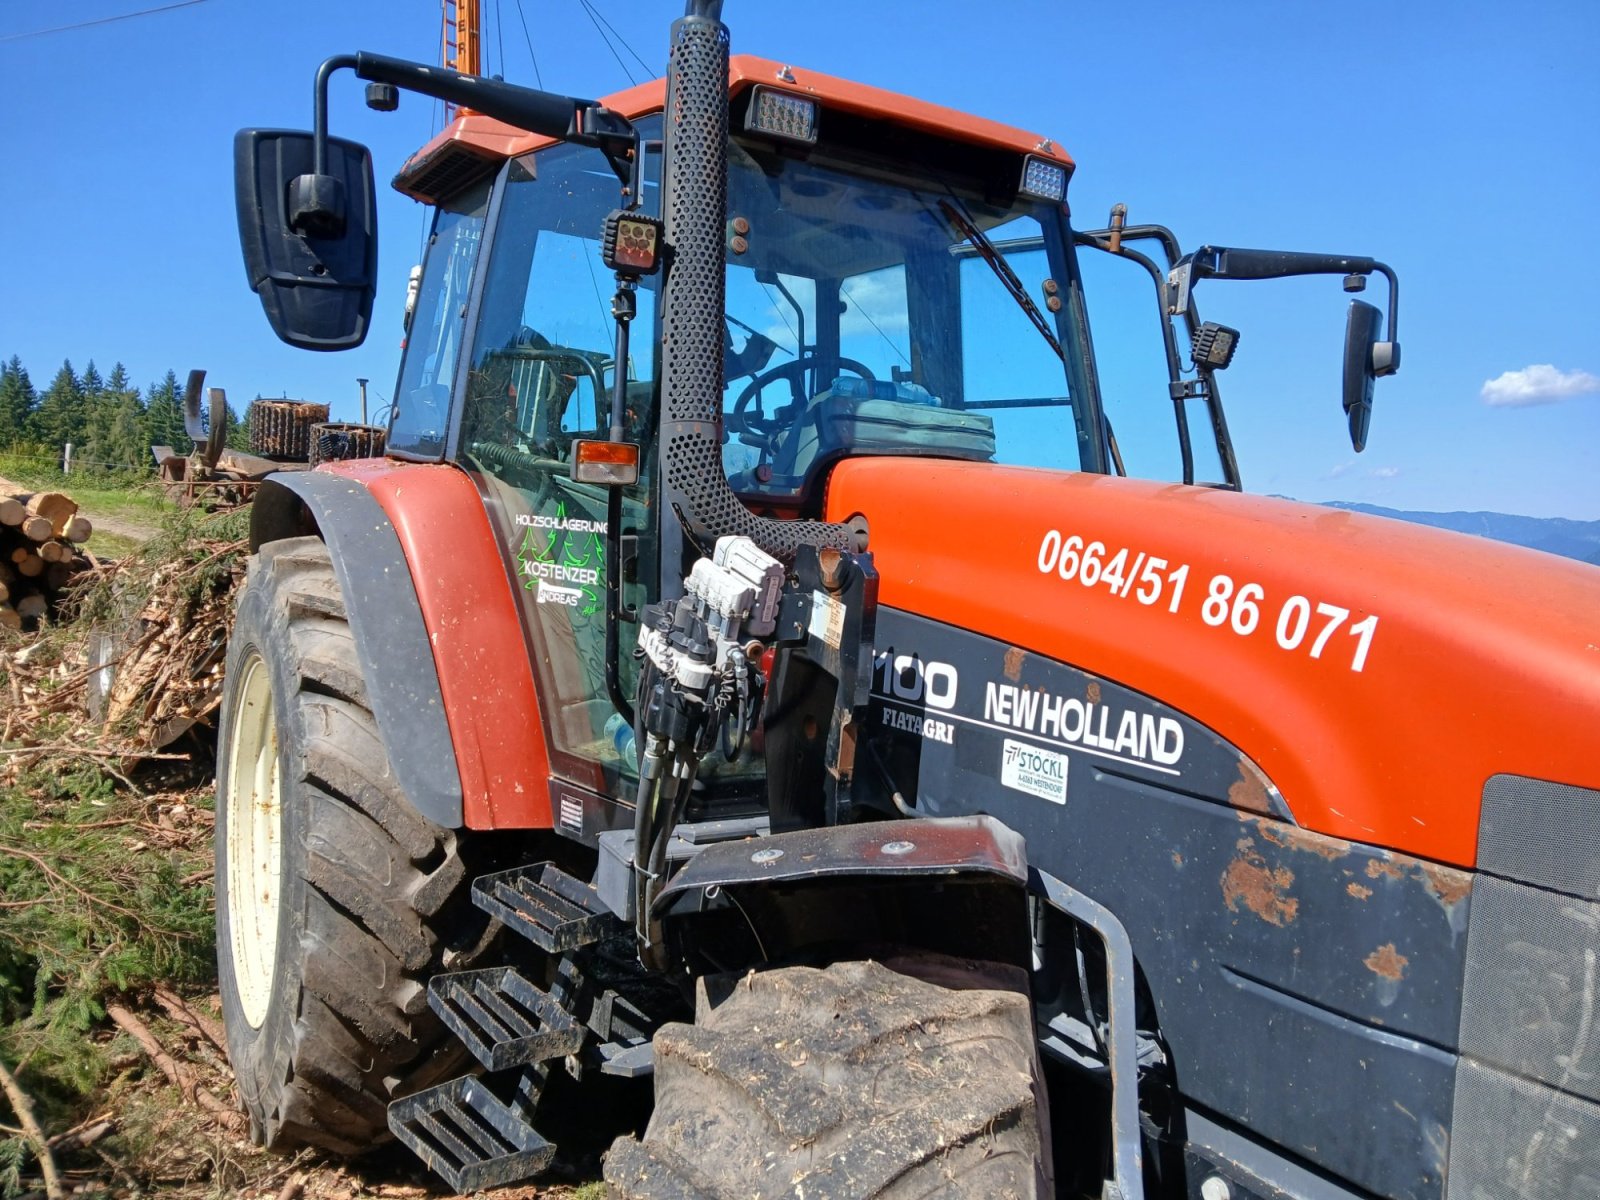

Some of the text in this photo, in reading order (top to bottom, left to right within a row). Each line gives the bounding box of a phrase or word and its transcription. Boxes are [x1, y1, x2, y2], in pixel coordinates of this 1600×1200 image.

[524, 560, 598, 585] KOSTENZER
[1037, 530, 1380, 673] 0664/51 86 071
[882, 707, 955, 744] FIATAGRI
[984, 681, 1184, 765] NEW HOLLAND
[1019, 750, 1064, 779] STÖCKL
